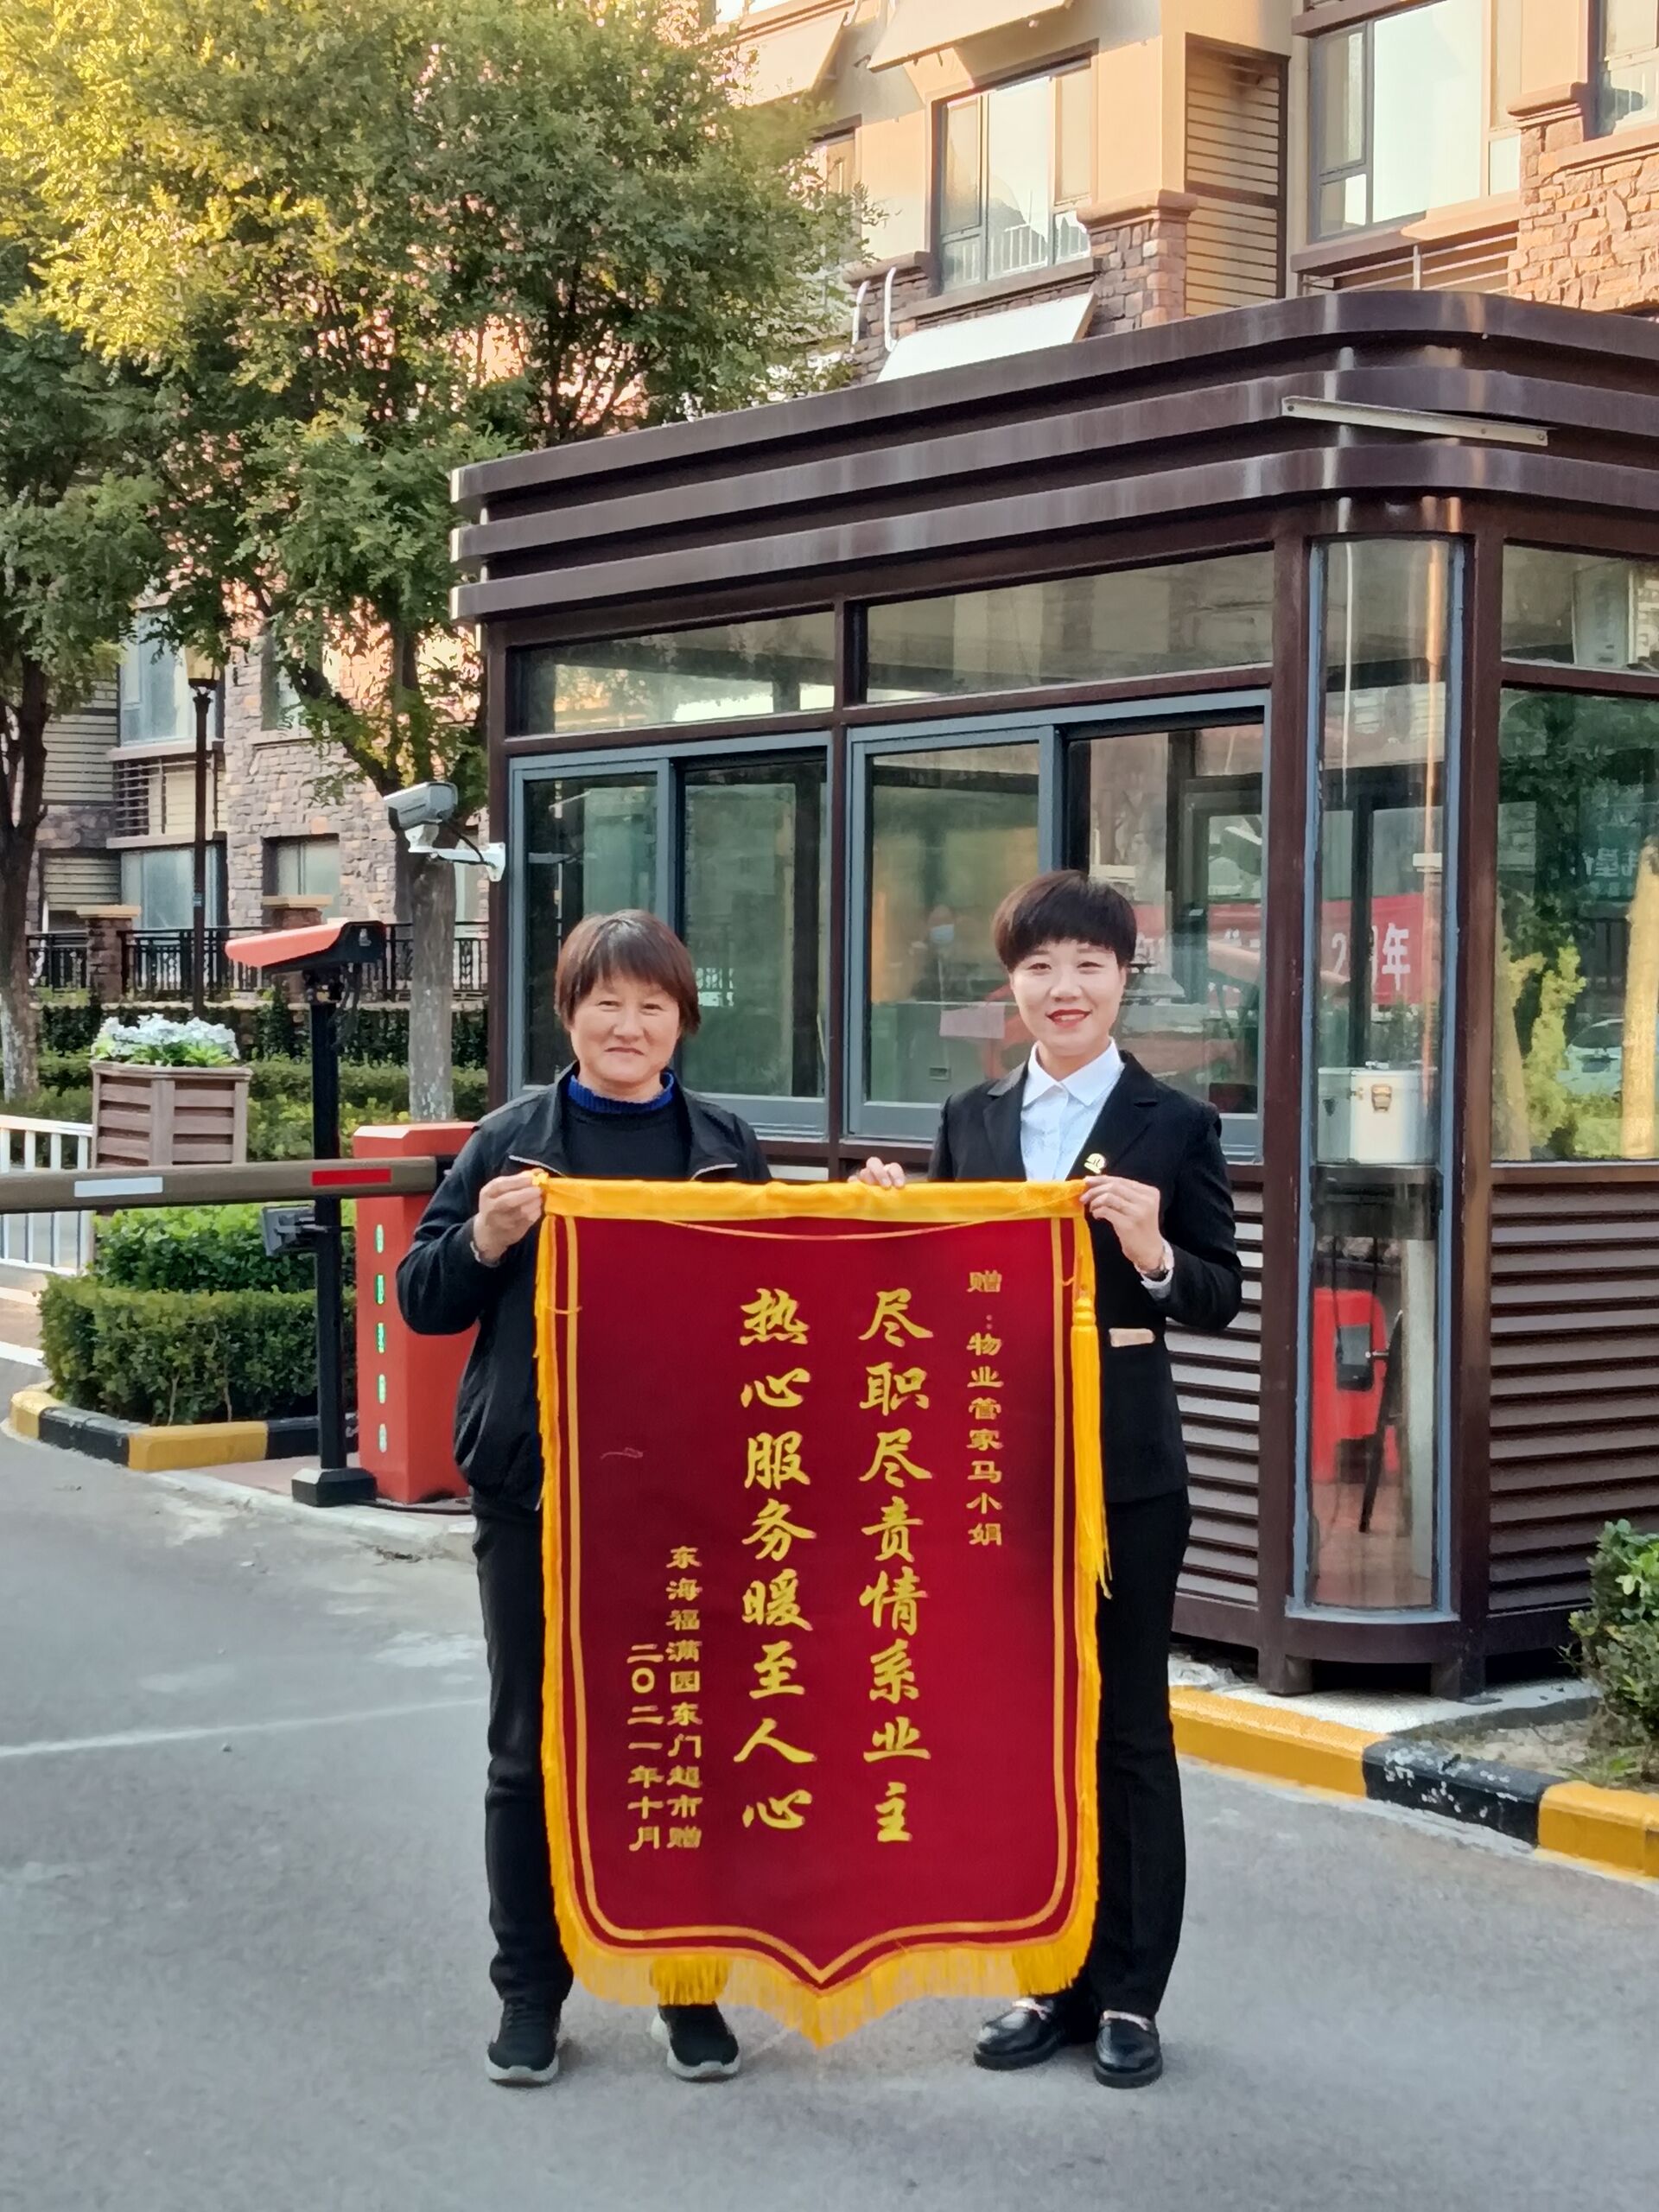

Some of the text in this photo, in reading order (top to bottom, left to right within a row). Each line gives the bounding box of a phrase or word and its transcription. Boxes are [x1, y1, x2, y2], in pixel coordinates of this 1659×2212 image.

[733, 1287, 817, 1830] 热心服务暖至人心
[858, 1287, 934, 1842] 尽职尽责情系业主
